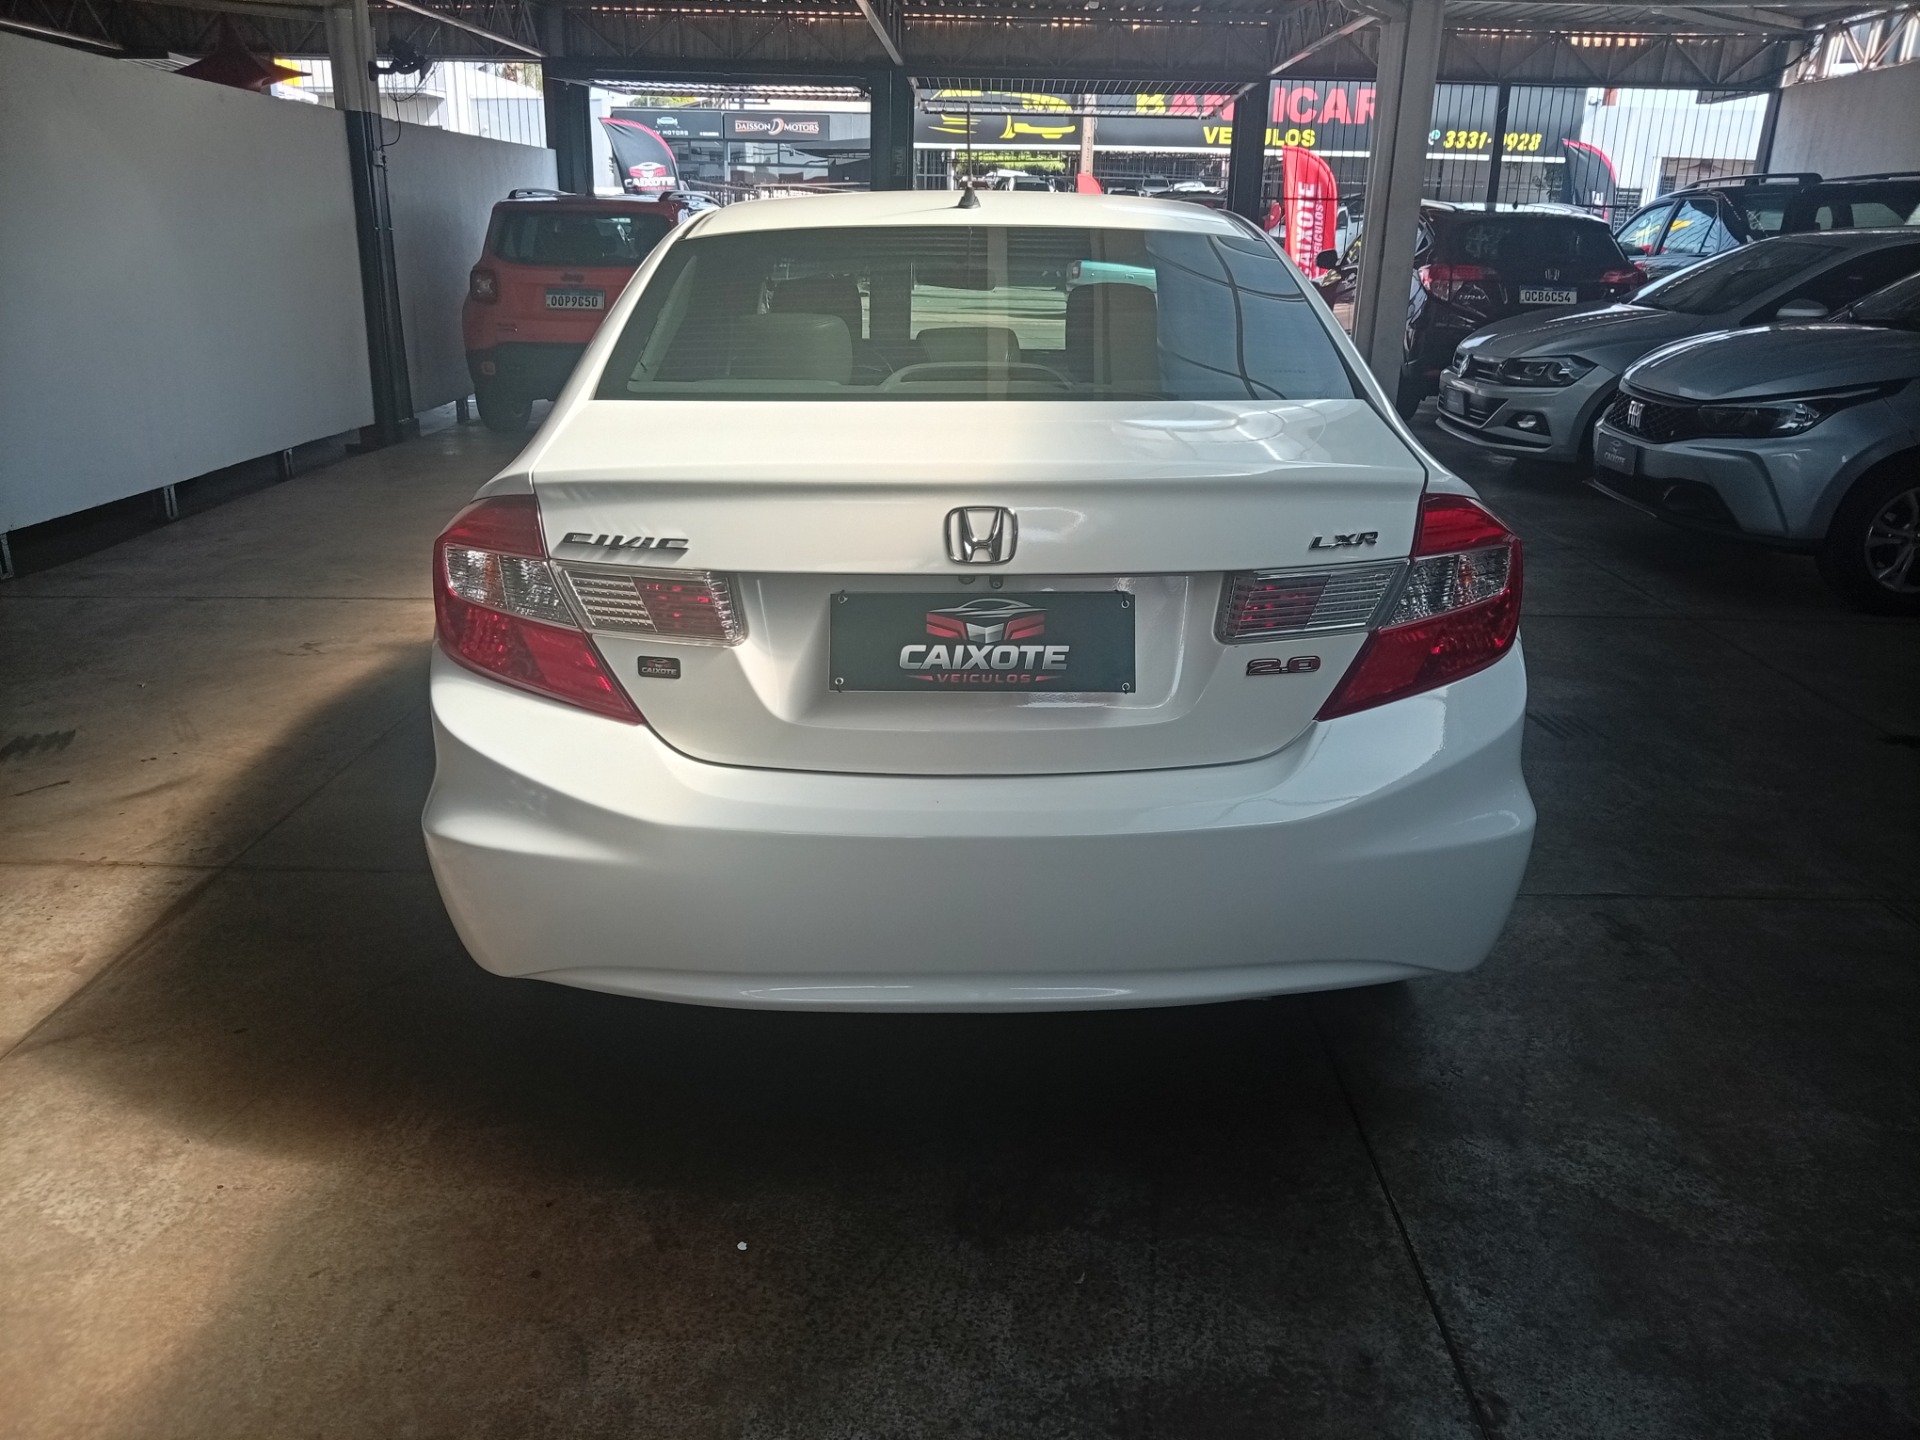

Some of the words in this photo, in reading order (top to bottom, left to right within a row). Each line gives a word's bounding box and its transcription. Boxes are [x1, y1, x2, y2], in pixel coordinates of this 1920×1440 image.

[1136, 87, 1377, 125] BANICAR
[735, 121, 770, 132] DAISSON
[784, 122, 820, 133] MOTORS
[1203, 126, 1316, 147] VELOS
[562, 532, 690, 551] CIVIC
[1308, 531, 1379, 550] LXR
[898, 644, 1071, 670] CAIXOTE
[1246, 656, 1321, 676] 2.0
[641, 666, 678, 676] CAIXOTE
[937, 672, 1031, 683] VEÍCULOS
